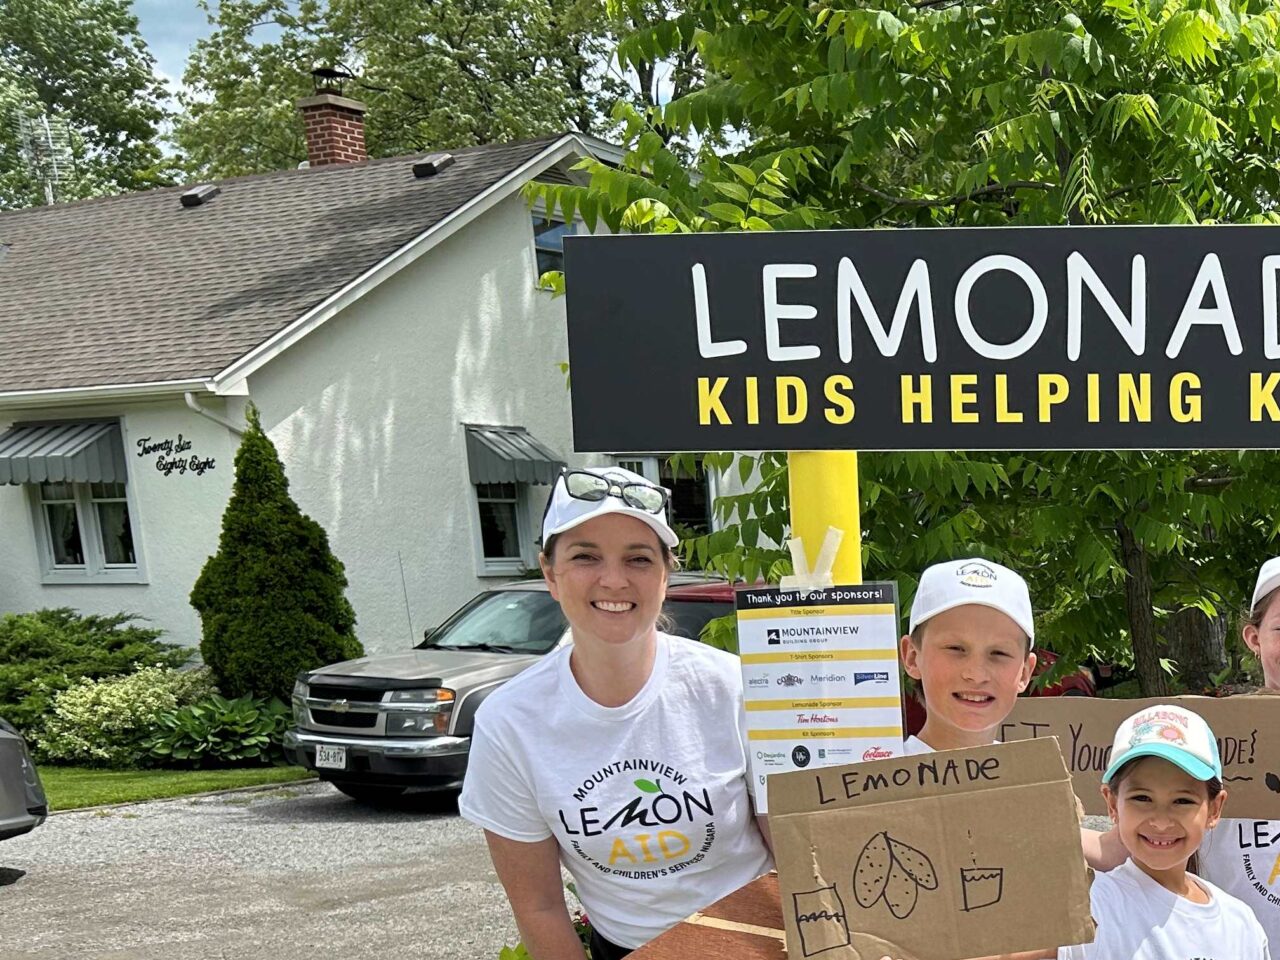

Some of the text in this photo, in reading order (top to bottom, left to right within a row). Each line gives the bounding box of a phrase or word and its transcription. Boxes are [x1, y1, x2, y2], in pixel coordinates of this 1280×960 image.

[697, 374, 856, 425] KIDS
[900, 371, 1203, 424] HELPING
[136, 433, 192, 457] Twenty Six
[156, 454, 216, 477] Eighty Eight
[746, 593, 773, 604] Thank
[775, 593, 793, 605] you
[810, 591, 828, 601] our
[831, 589, 883, 601] sponsors!
[781, 626, 859, 637] MOUNTAINVIEW
[811, 674, 846, 682] Meridian
[797, 713, 839, 724] Tim Hortons
[572, 758, 688, 802] MOUNTAINVIEW
[558, 787, 714, 837] LEMON
[571, 821, 716, 880] FAMILY AND CHILDREN'S SERVICES NIAGARA
[607, 829, 692, 866] AID
[1242, 853, 1257, 882] FAMILY
[1252, 880, 1268, 897] AND
